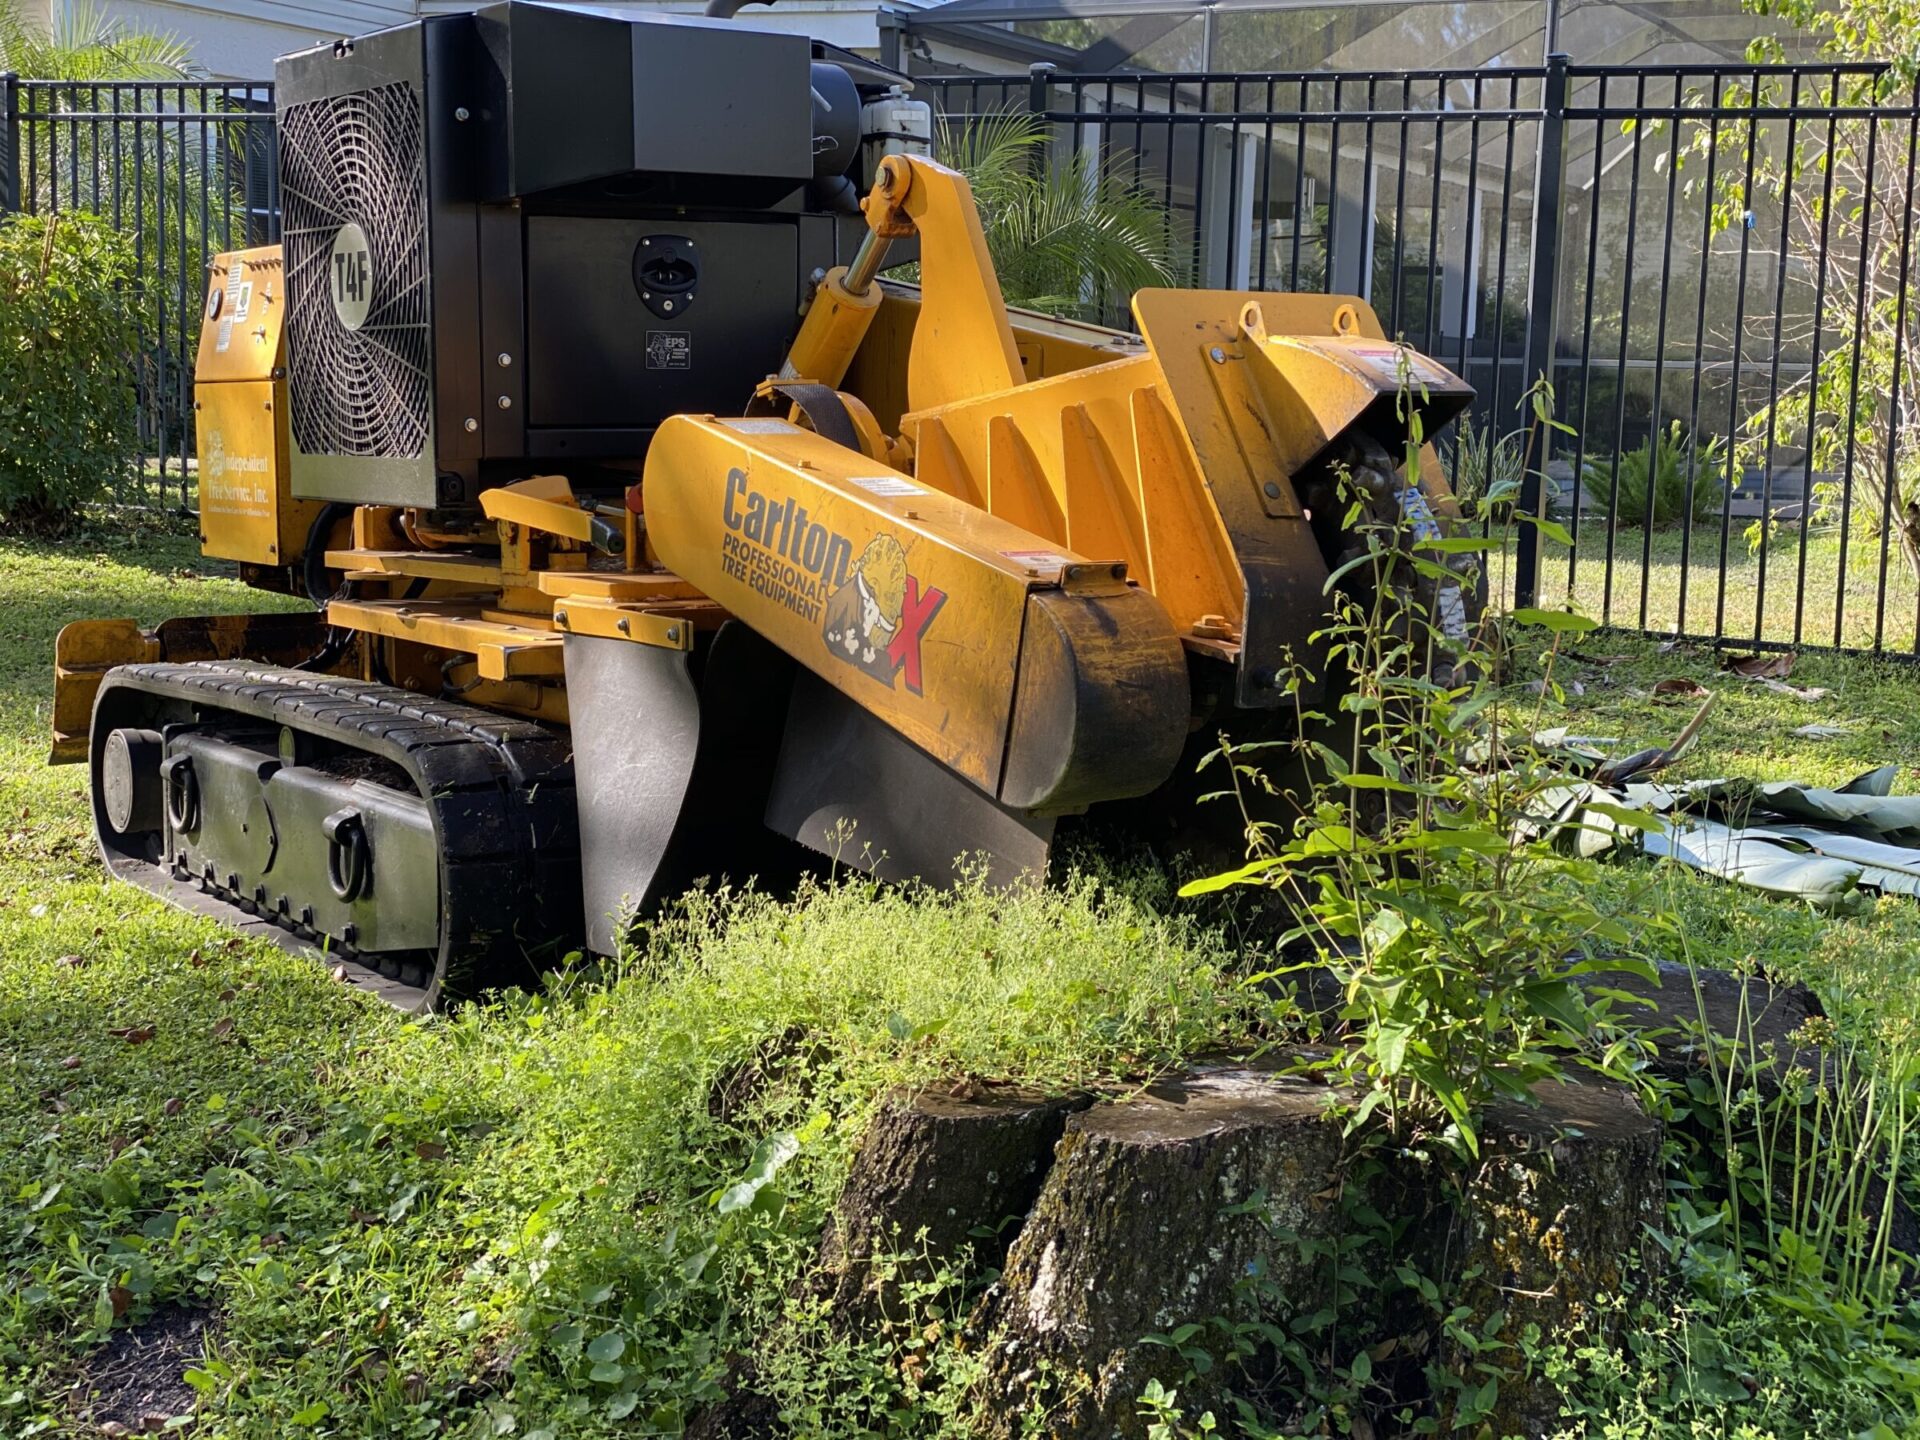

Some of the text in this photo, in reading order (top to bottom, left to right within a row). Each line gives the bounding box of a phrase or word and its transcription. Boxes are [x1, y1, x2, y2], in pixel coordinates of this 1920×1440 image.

[335, 251, 367, 303] T4F
[665, 338, 686, 348] EPS
[208, 480, 223, 500] Tree
[222, 452, 268, 477] Independent
[723, 467, 853, 588] Carlton
[721, 553, 822, 625] TREE EQUIPMENT
[722, 533, 823, 604] PROFESSIONAL
[886, 574, 948, 698] X
